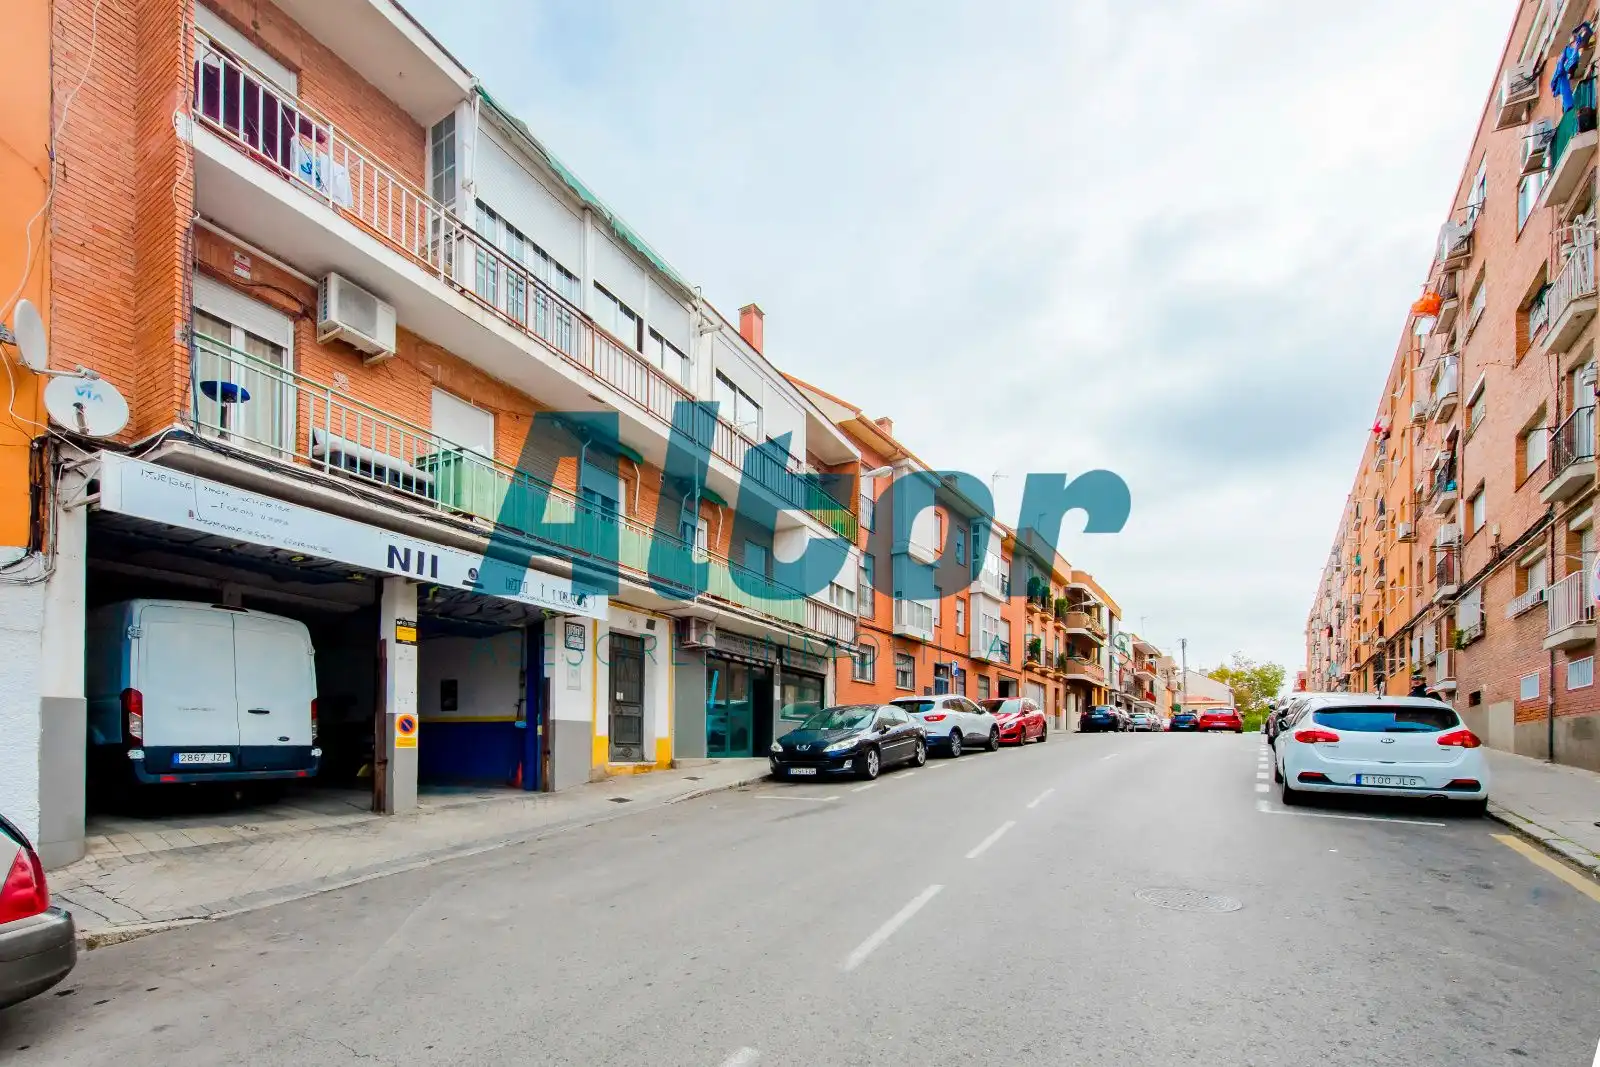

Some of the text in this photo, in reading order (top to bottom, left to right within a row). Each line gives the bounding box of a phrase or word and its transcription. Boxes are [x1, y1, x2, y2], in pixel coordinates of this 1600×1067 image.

[180, 753, 228, 762] 2867 JZP
[1363, 776, 1416, 786] 1100 JLG
